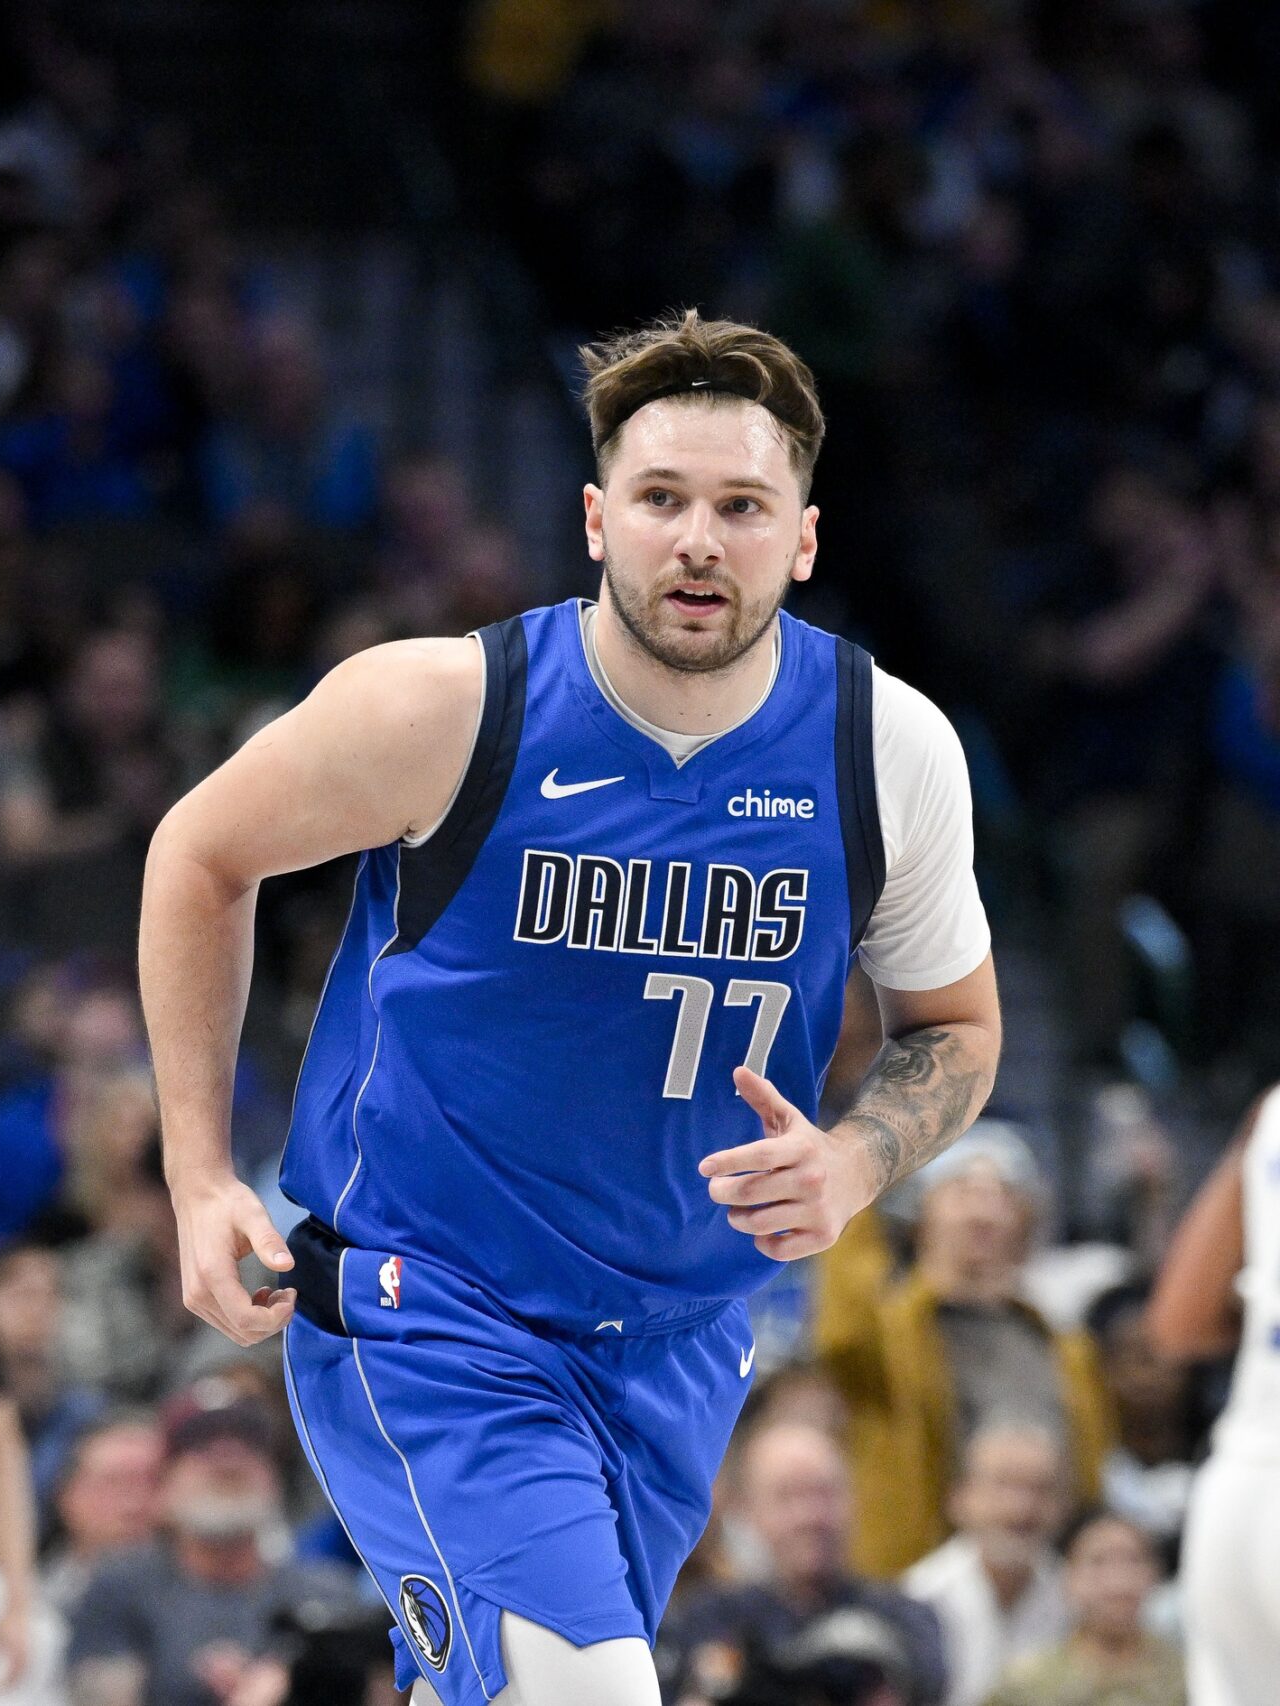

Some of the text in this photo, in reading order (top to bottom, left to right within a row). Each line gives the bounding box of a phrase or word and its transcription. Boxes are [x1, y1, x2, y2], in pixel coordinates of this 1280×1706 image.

[727, 789, 814, 819] chime
[513, 848, 809, 962] DALLAS
[643, 972, 792, 1100] 77
[380, 1296, 393, 1307] NBA
